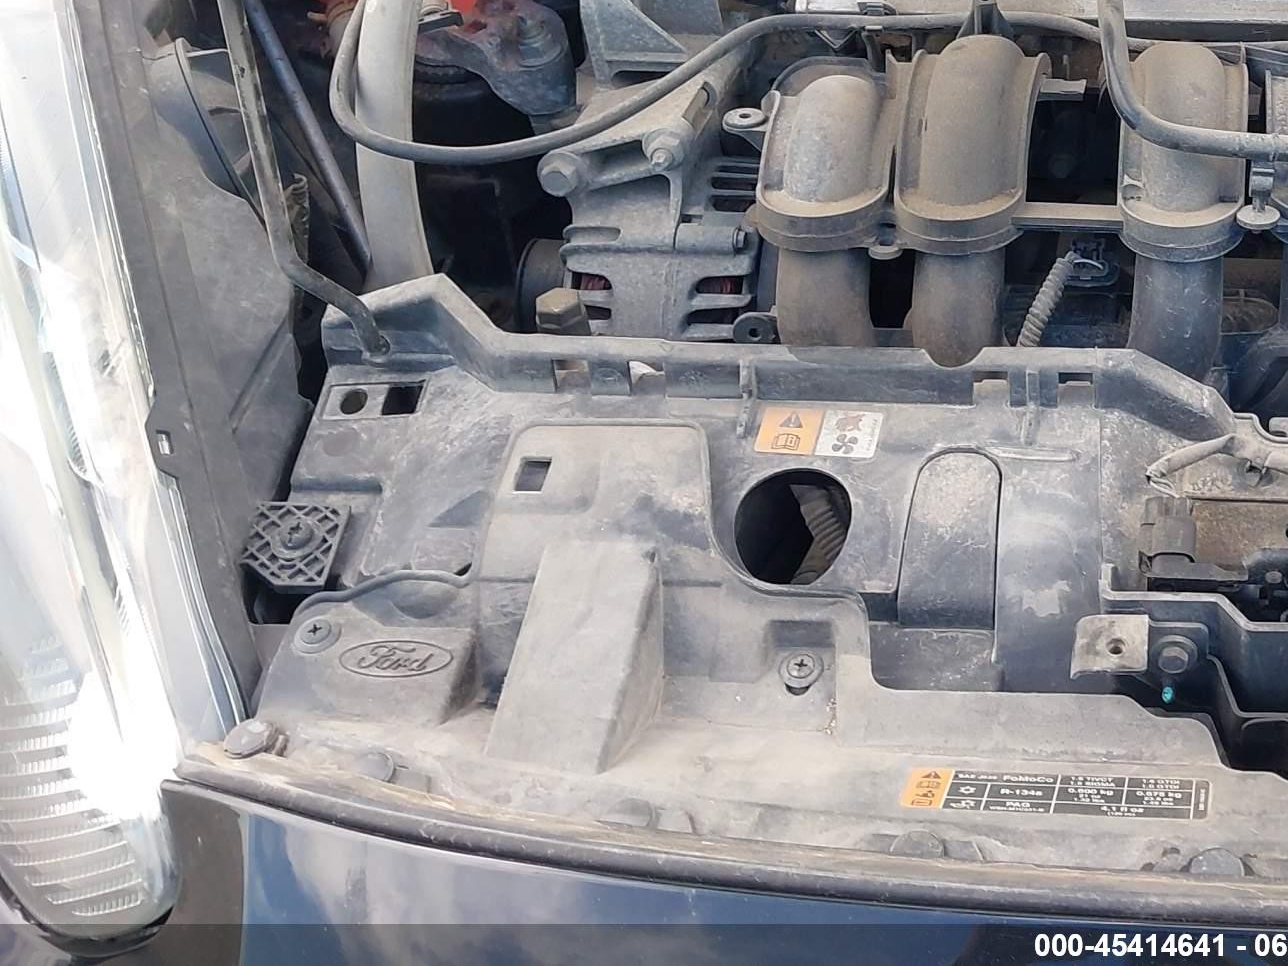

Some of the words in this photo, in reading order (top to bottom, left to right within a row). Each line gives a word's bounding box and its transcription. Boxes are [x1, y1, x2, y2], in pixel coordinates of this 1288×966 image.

[357, 645, 434, 671] Ford
[1002, 774, 1055, 784] FoMoCo
[1000, 787, 1044, 797] R-134a
[1099, 788, 1114, 797] kg
[1168, 791, 1183, 799] kg
[1005, 800, 1031, 808] PAG
